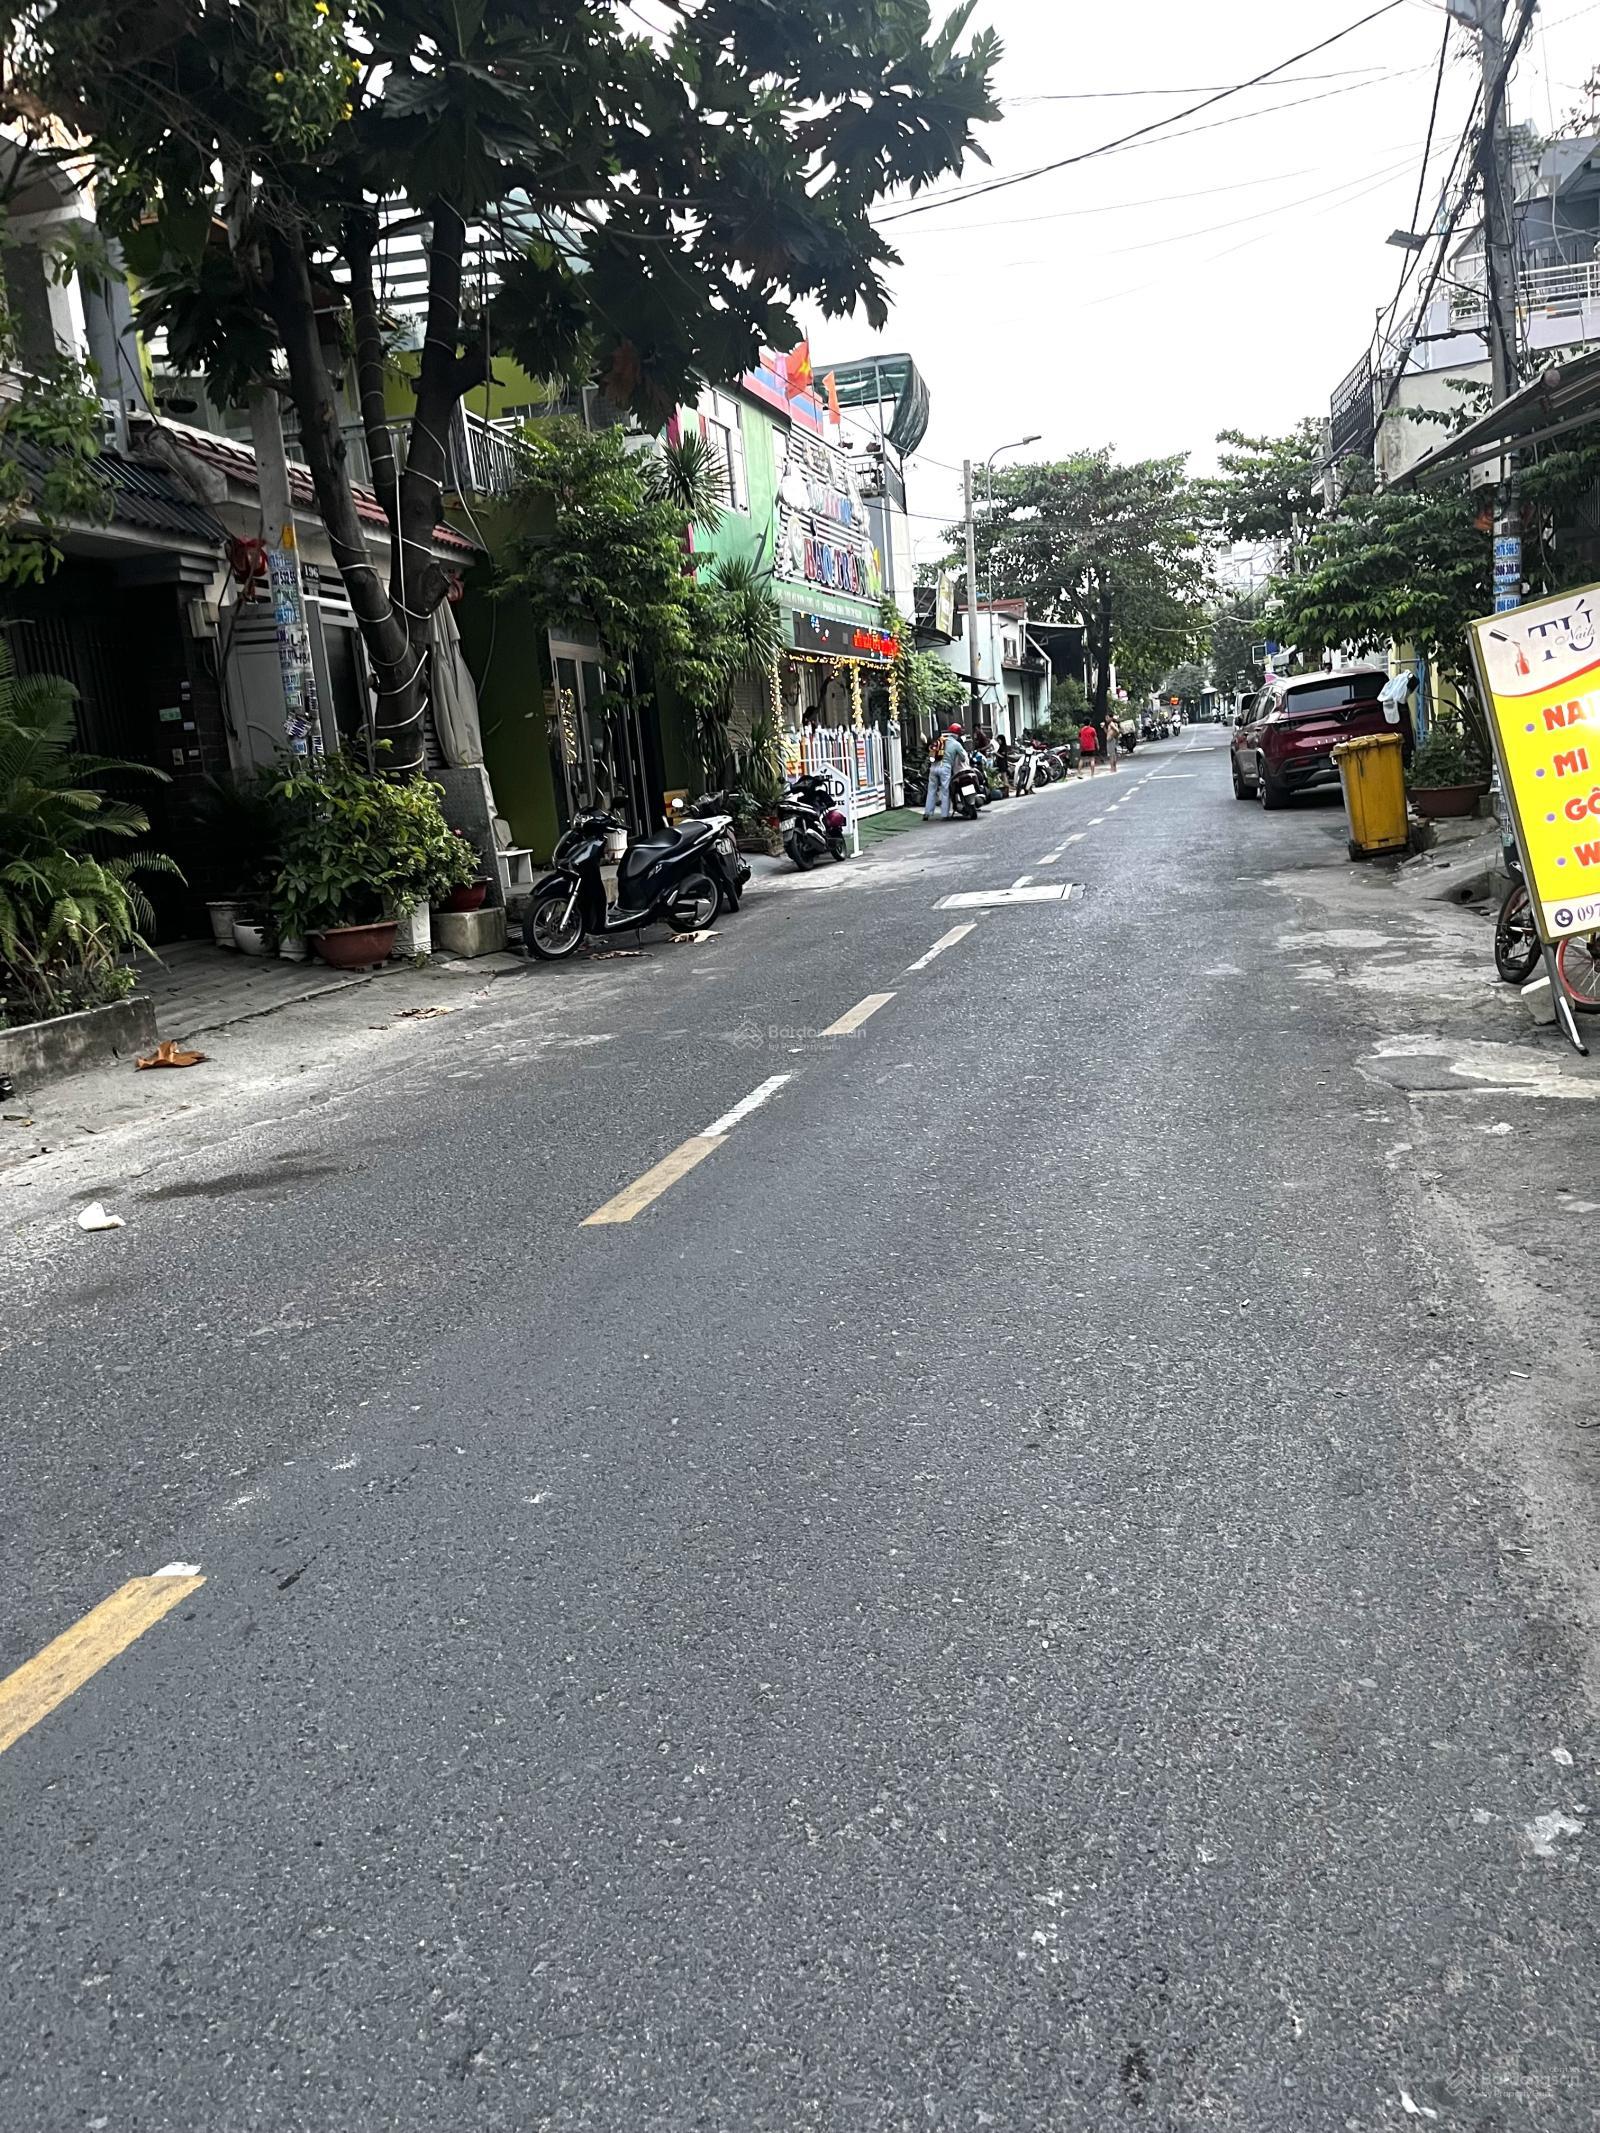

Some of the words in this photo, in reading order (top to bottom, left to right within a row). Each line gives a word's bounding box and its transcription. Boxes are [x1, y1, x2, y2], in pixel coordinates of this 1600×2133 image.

[304, 564, 319, 578] 196
[1558, 624, 1596, 644] Nails
[1552, 747, 1589, 777] MI
